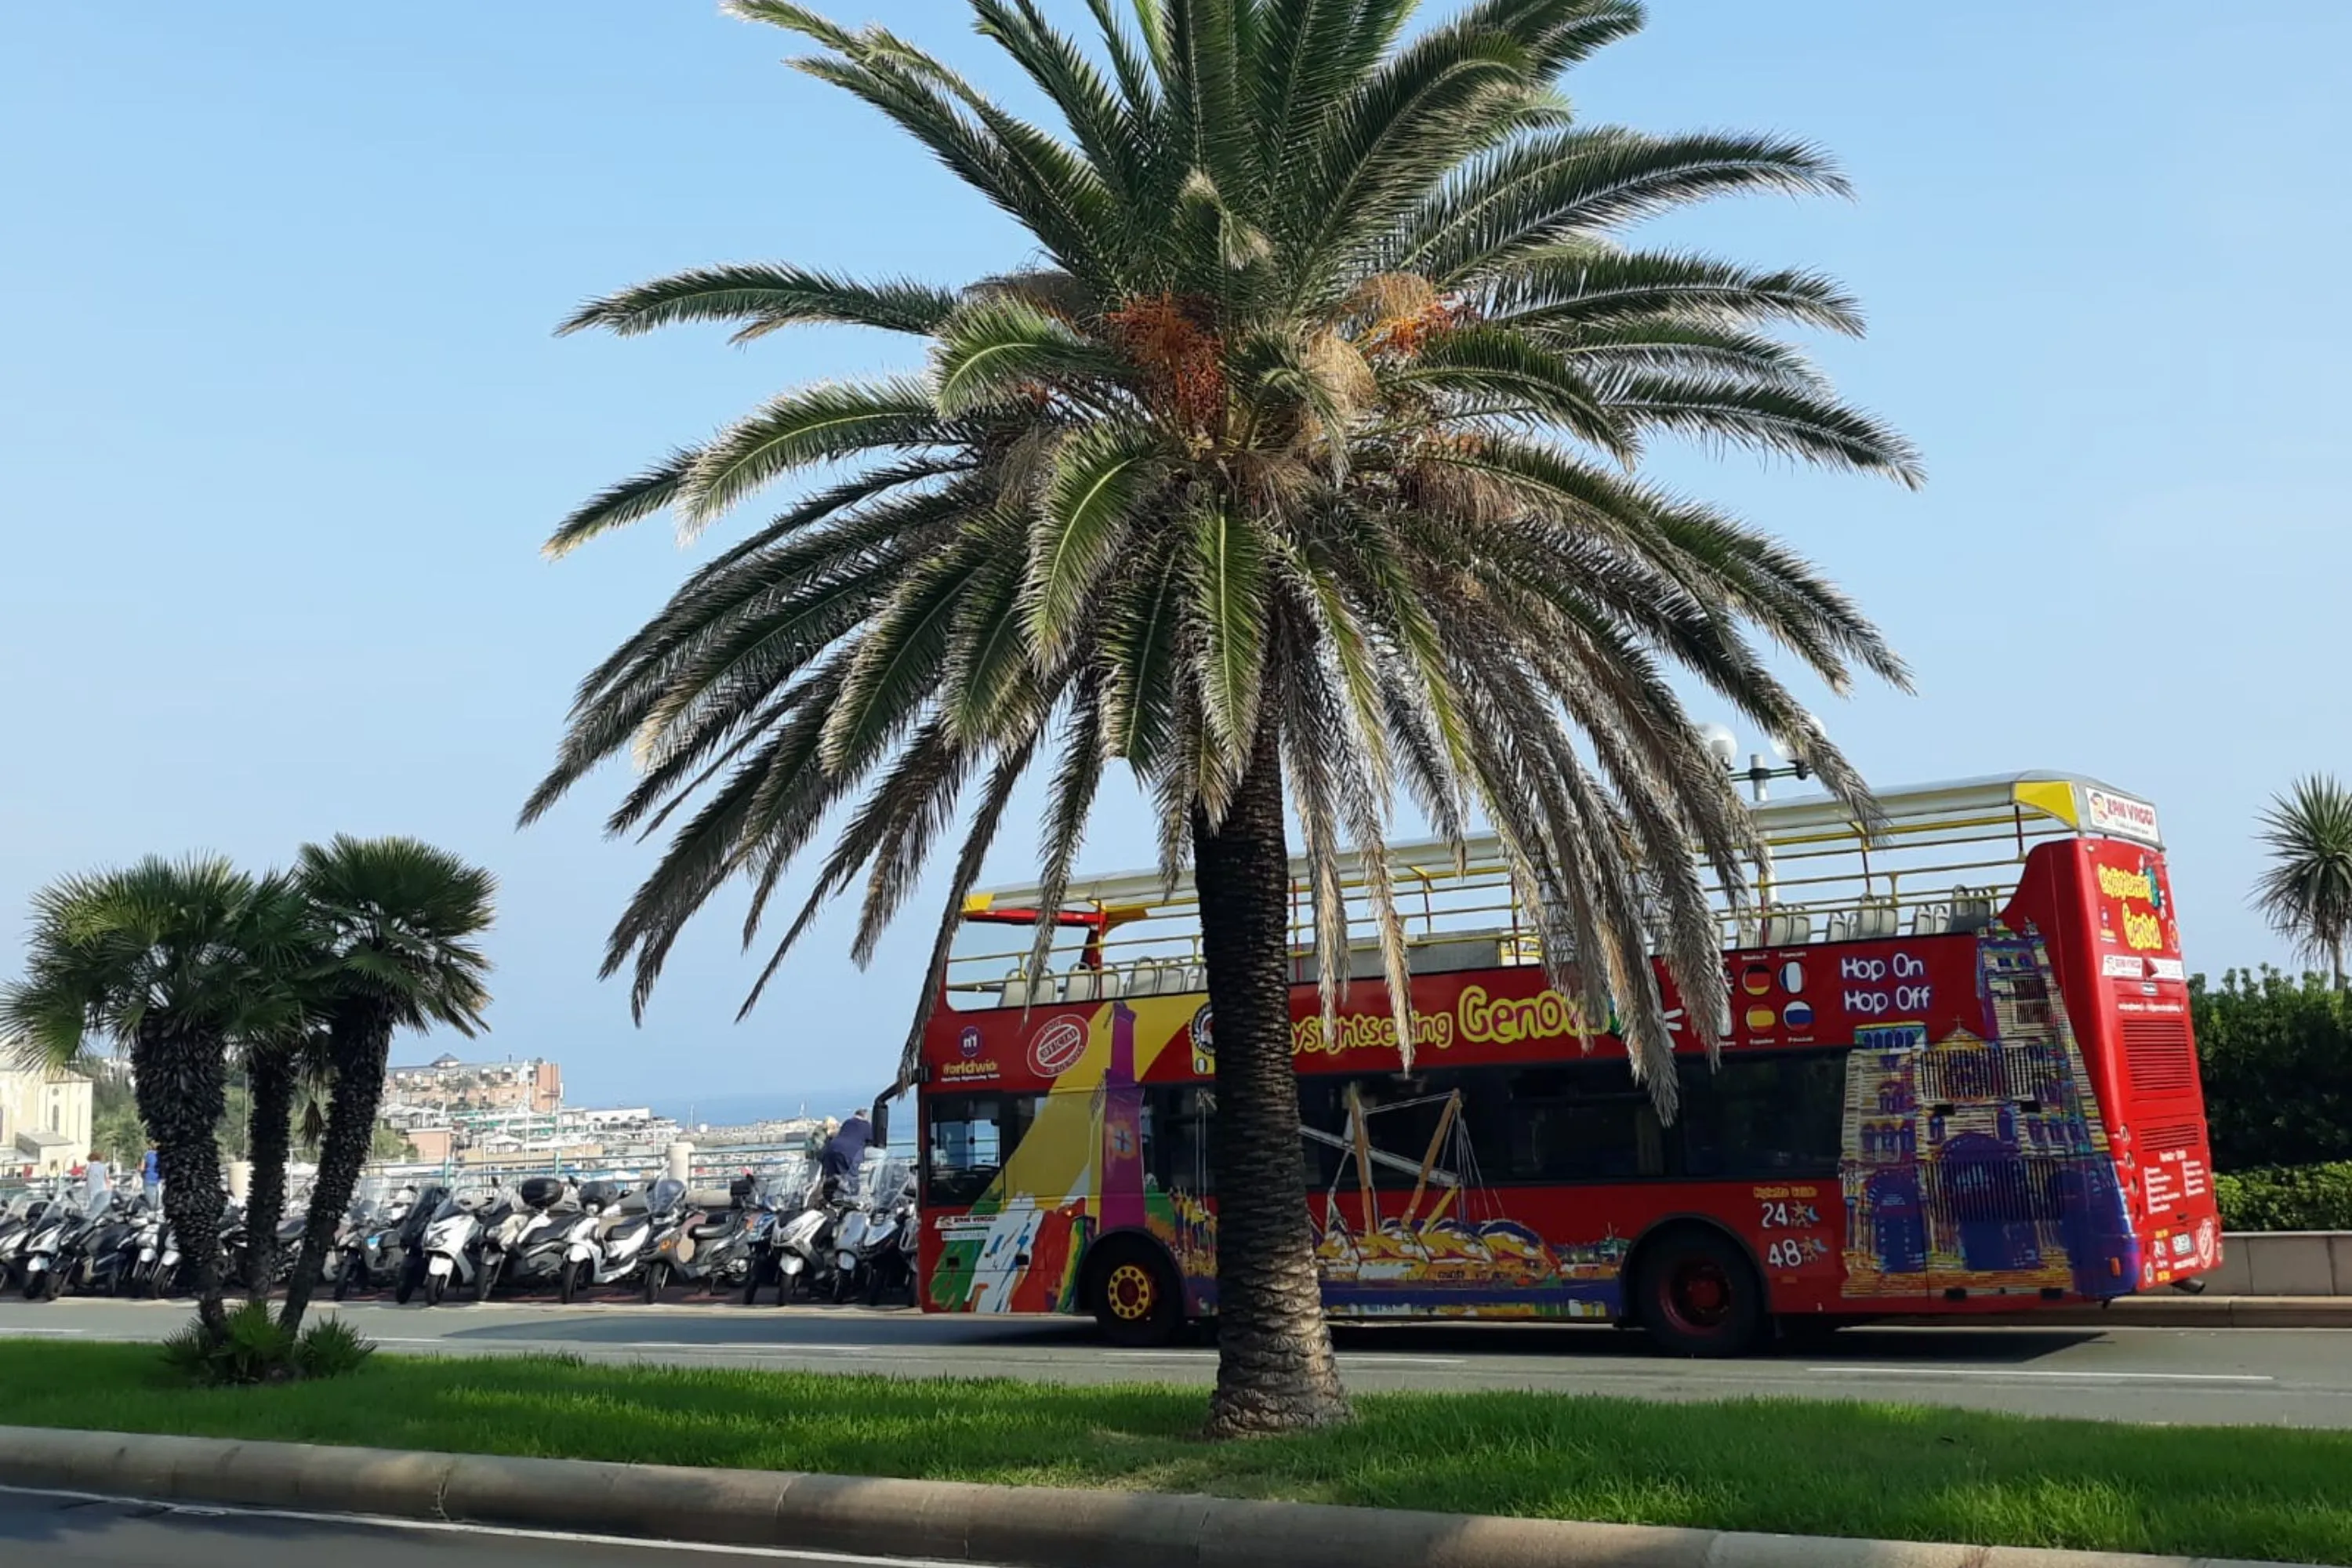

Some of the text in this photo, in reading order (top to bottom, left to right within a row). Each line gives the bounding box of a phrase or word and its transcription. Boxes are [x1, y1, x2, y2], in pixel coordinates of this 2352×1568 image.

[1842, 953, 1923, 982] Hop On
[1844, 985, 1931, 1014] Hop Off
[1458, 985, 1610, 1044] Genov
[1762, 1202, 1788, 1229] 24
[1768, 1239, 1802, 1268] 48
